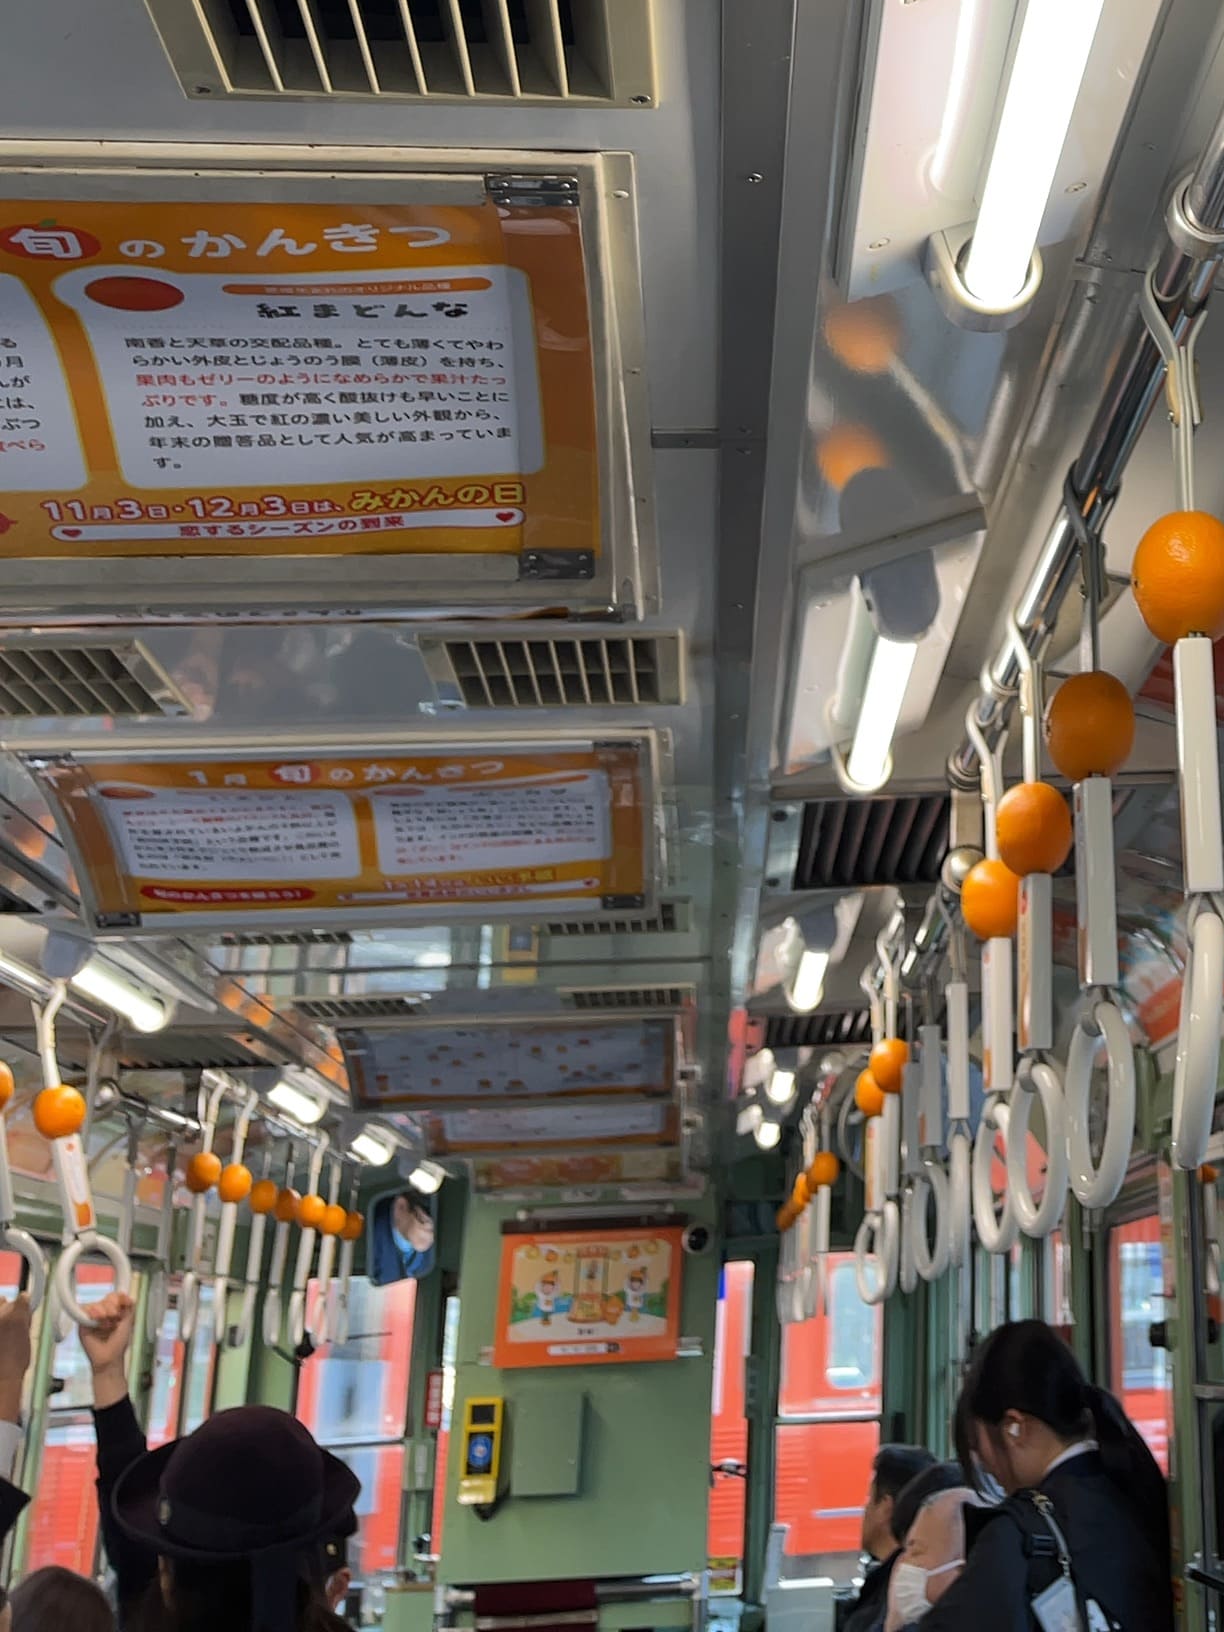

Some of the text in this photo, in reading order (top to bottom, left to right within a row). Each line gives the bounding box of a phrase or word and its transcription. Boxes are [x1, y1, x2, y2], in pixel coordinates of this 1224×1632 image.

[9, 222, 453, 259] 旬のかんきつ
[256, 302, 468, 319] 紅まどんな
[0, 356, 24, 368] 月
[152, 456, 183, 469] す。
[178, 515, 406, 536] 恋するシーズンの到来
